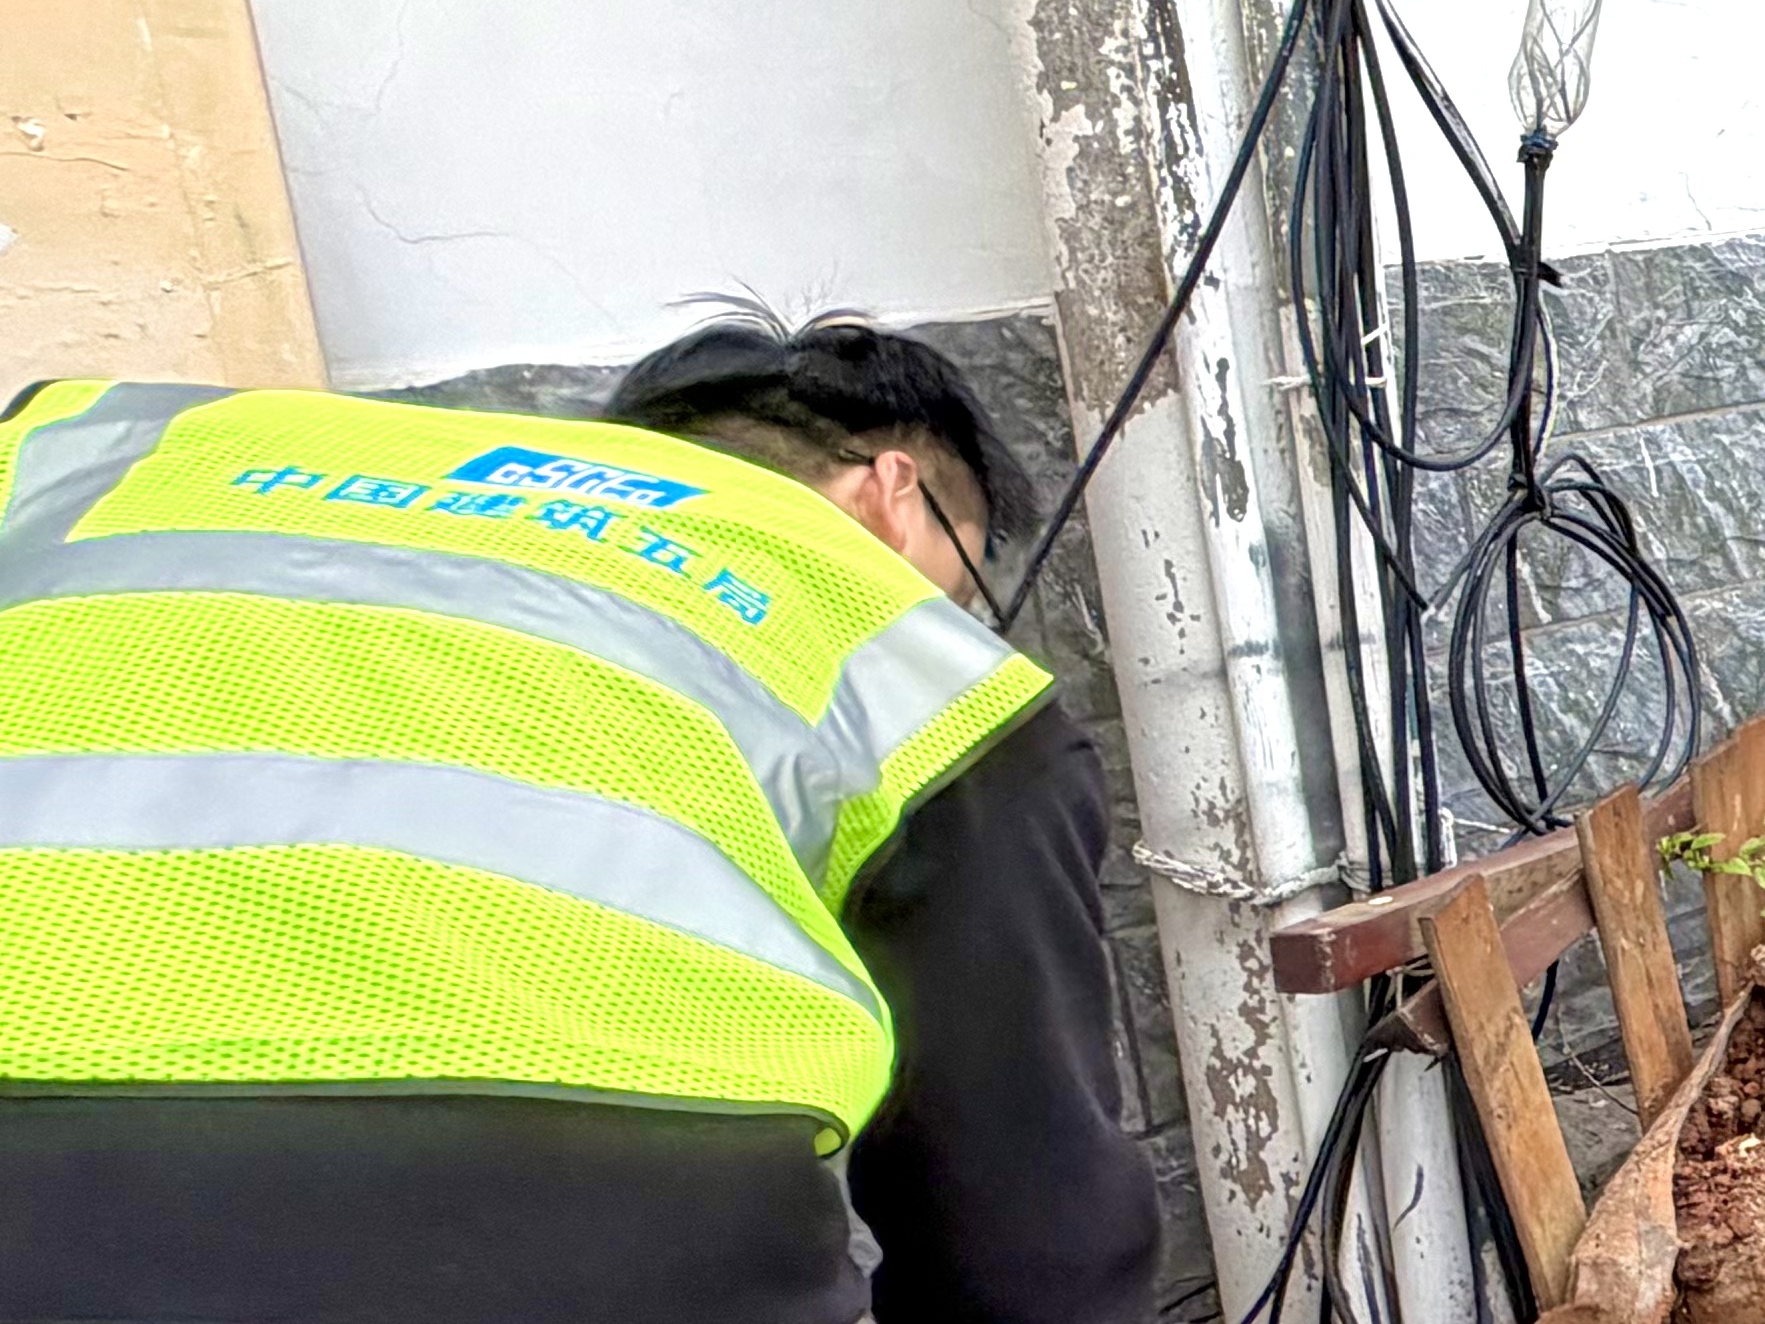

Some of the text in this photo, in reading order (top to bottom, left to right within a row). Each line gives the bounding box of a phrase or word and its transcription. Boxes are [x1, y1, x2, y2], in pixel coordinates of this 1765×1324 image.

[228, 465, 772, 627] 中国建筑五局
